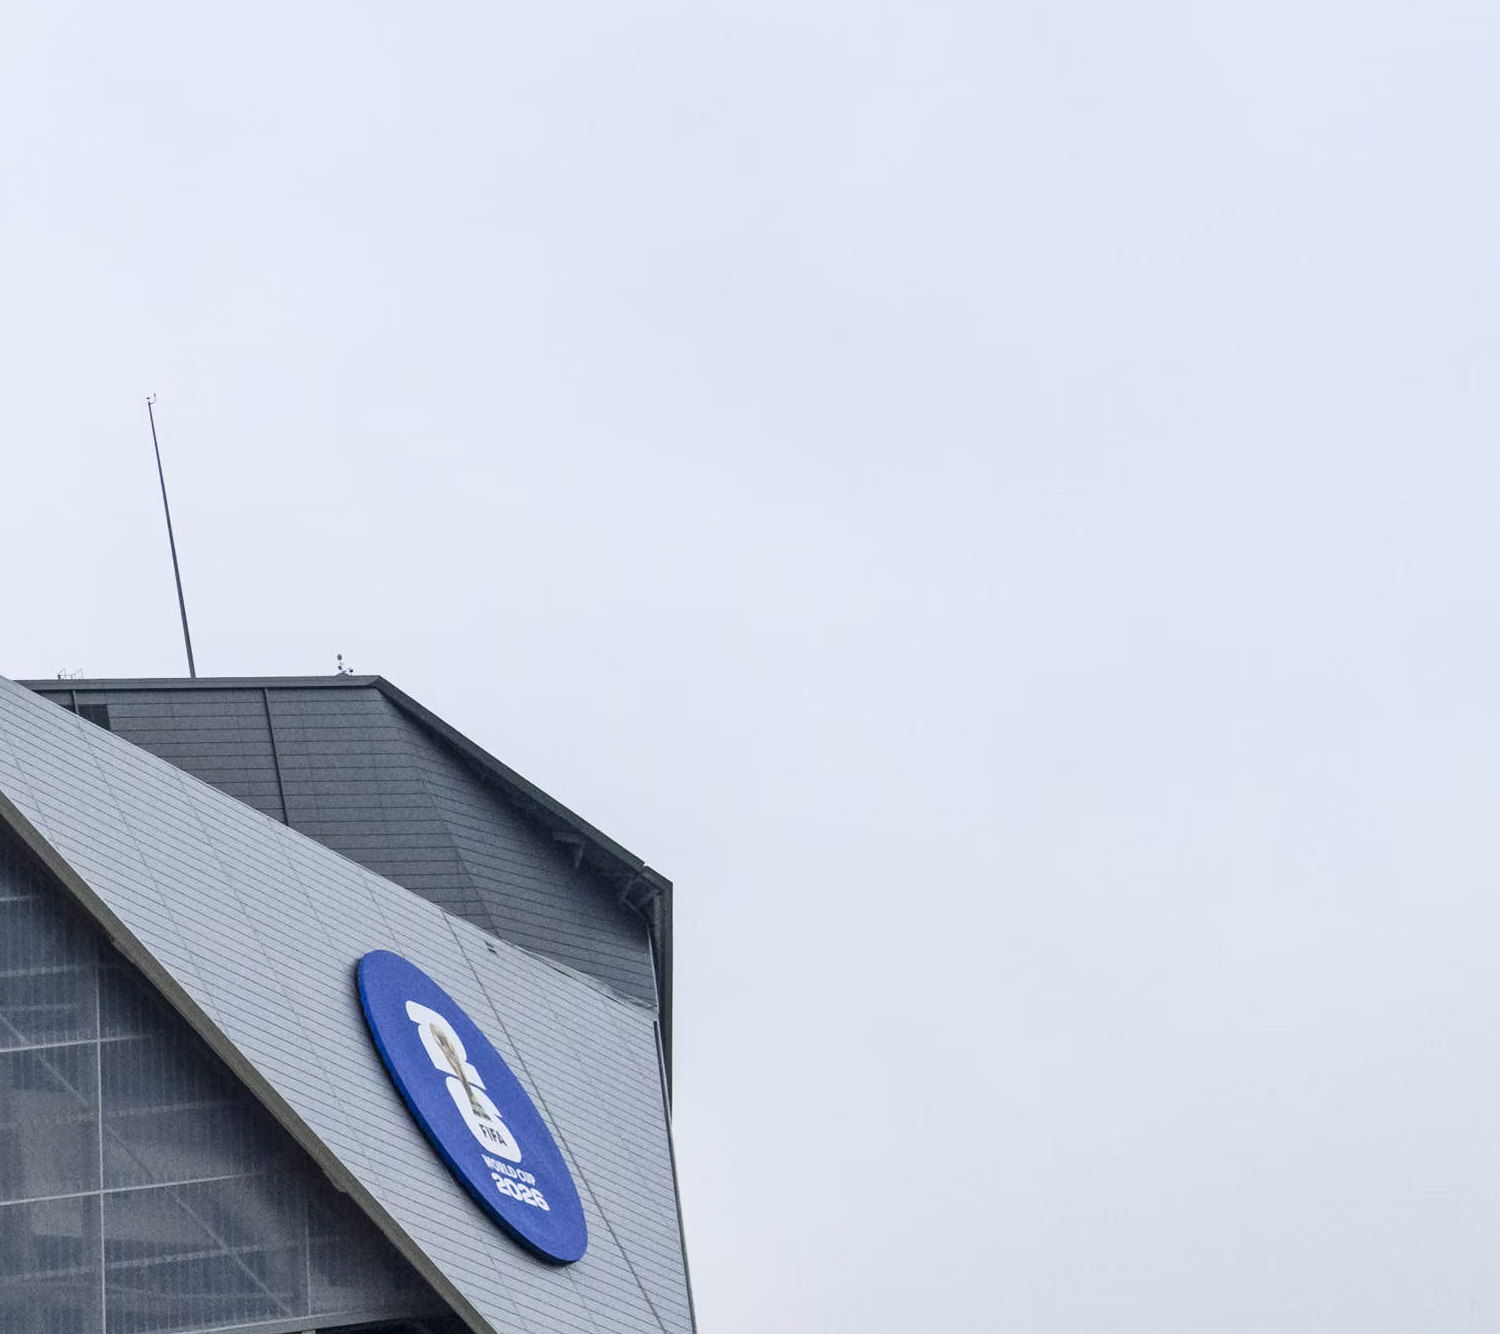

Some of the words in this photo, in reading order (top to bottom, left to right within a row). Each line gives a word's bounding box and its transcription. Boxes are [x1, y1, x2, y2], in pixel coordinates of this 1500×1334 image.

[479, 1123, 507, 1147] FIFA
[481, 1154, 518, 1179] WORLD
[515, 1168, 536, 1186] CUP
[491, 1172, 550, 1211] 2026
